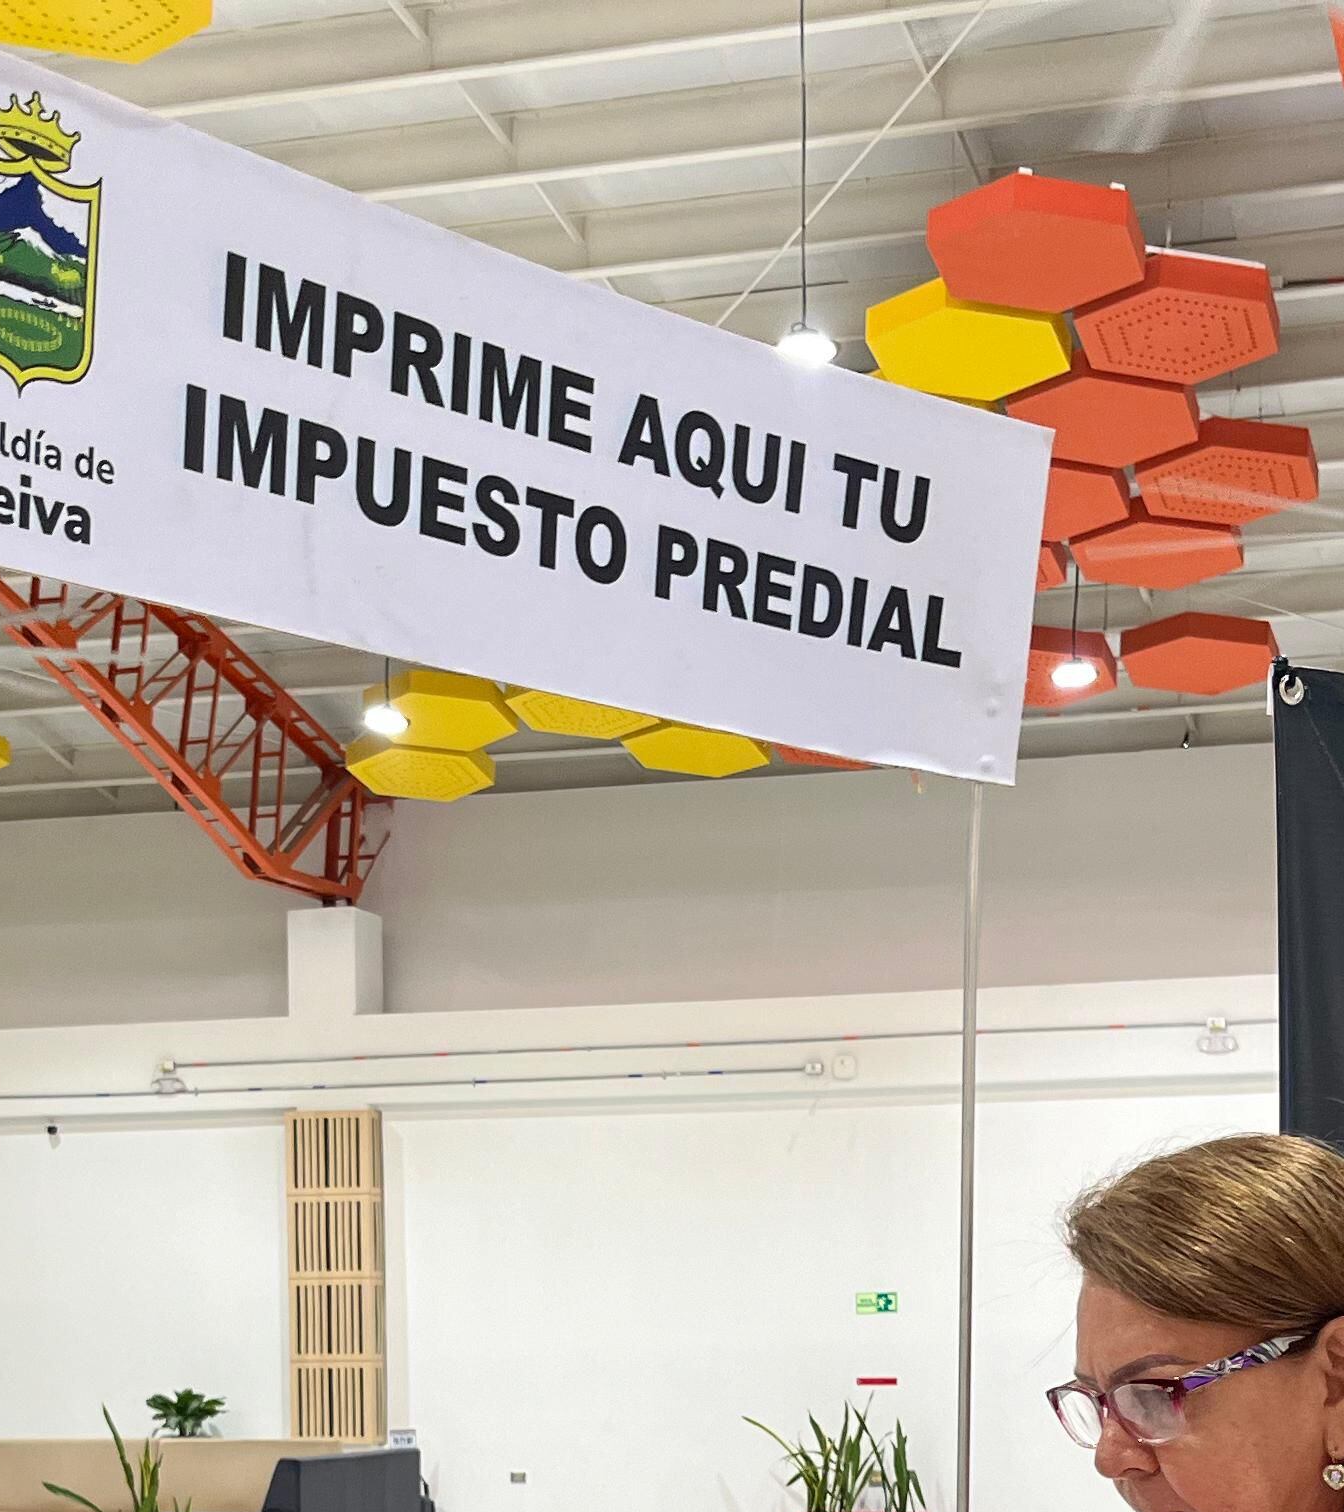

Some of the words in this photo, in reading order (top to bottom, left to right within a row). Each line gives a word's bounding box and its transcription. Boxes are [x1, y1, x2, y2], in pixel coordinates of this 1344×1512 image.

[74, 446, 115, 485] de
[182, 384, 627, 585] IMPUESTO
[654, 525, 963, 669] PREDIAL
[222, 251, 594, 453] IMPRIME
[617, 394, 806, 514] AQUI
[832, 453, 930, 544] TU
